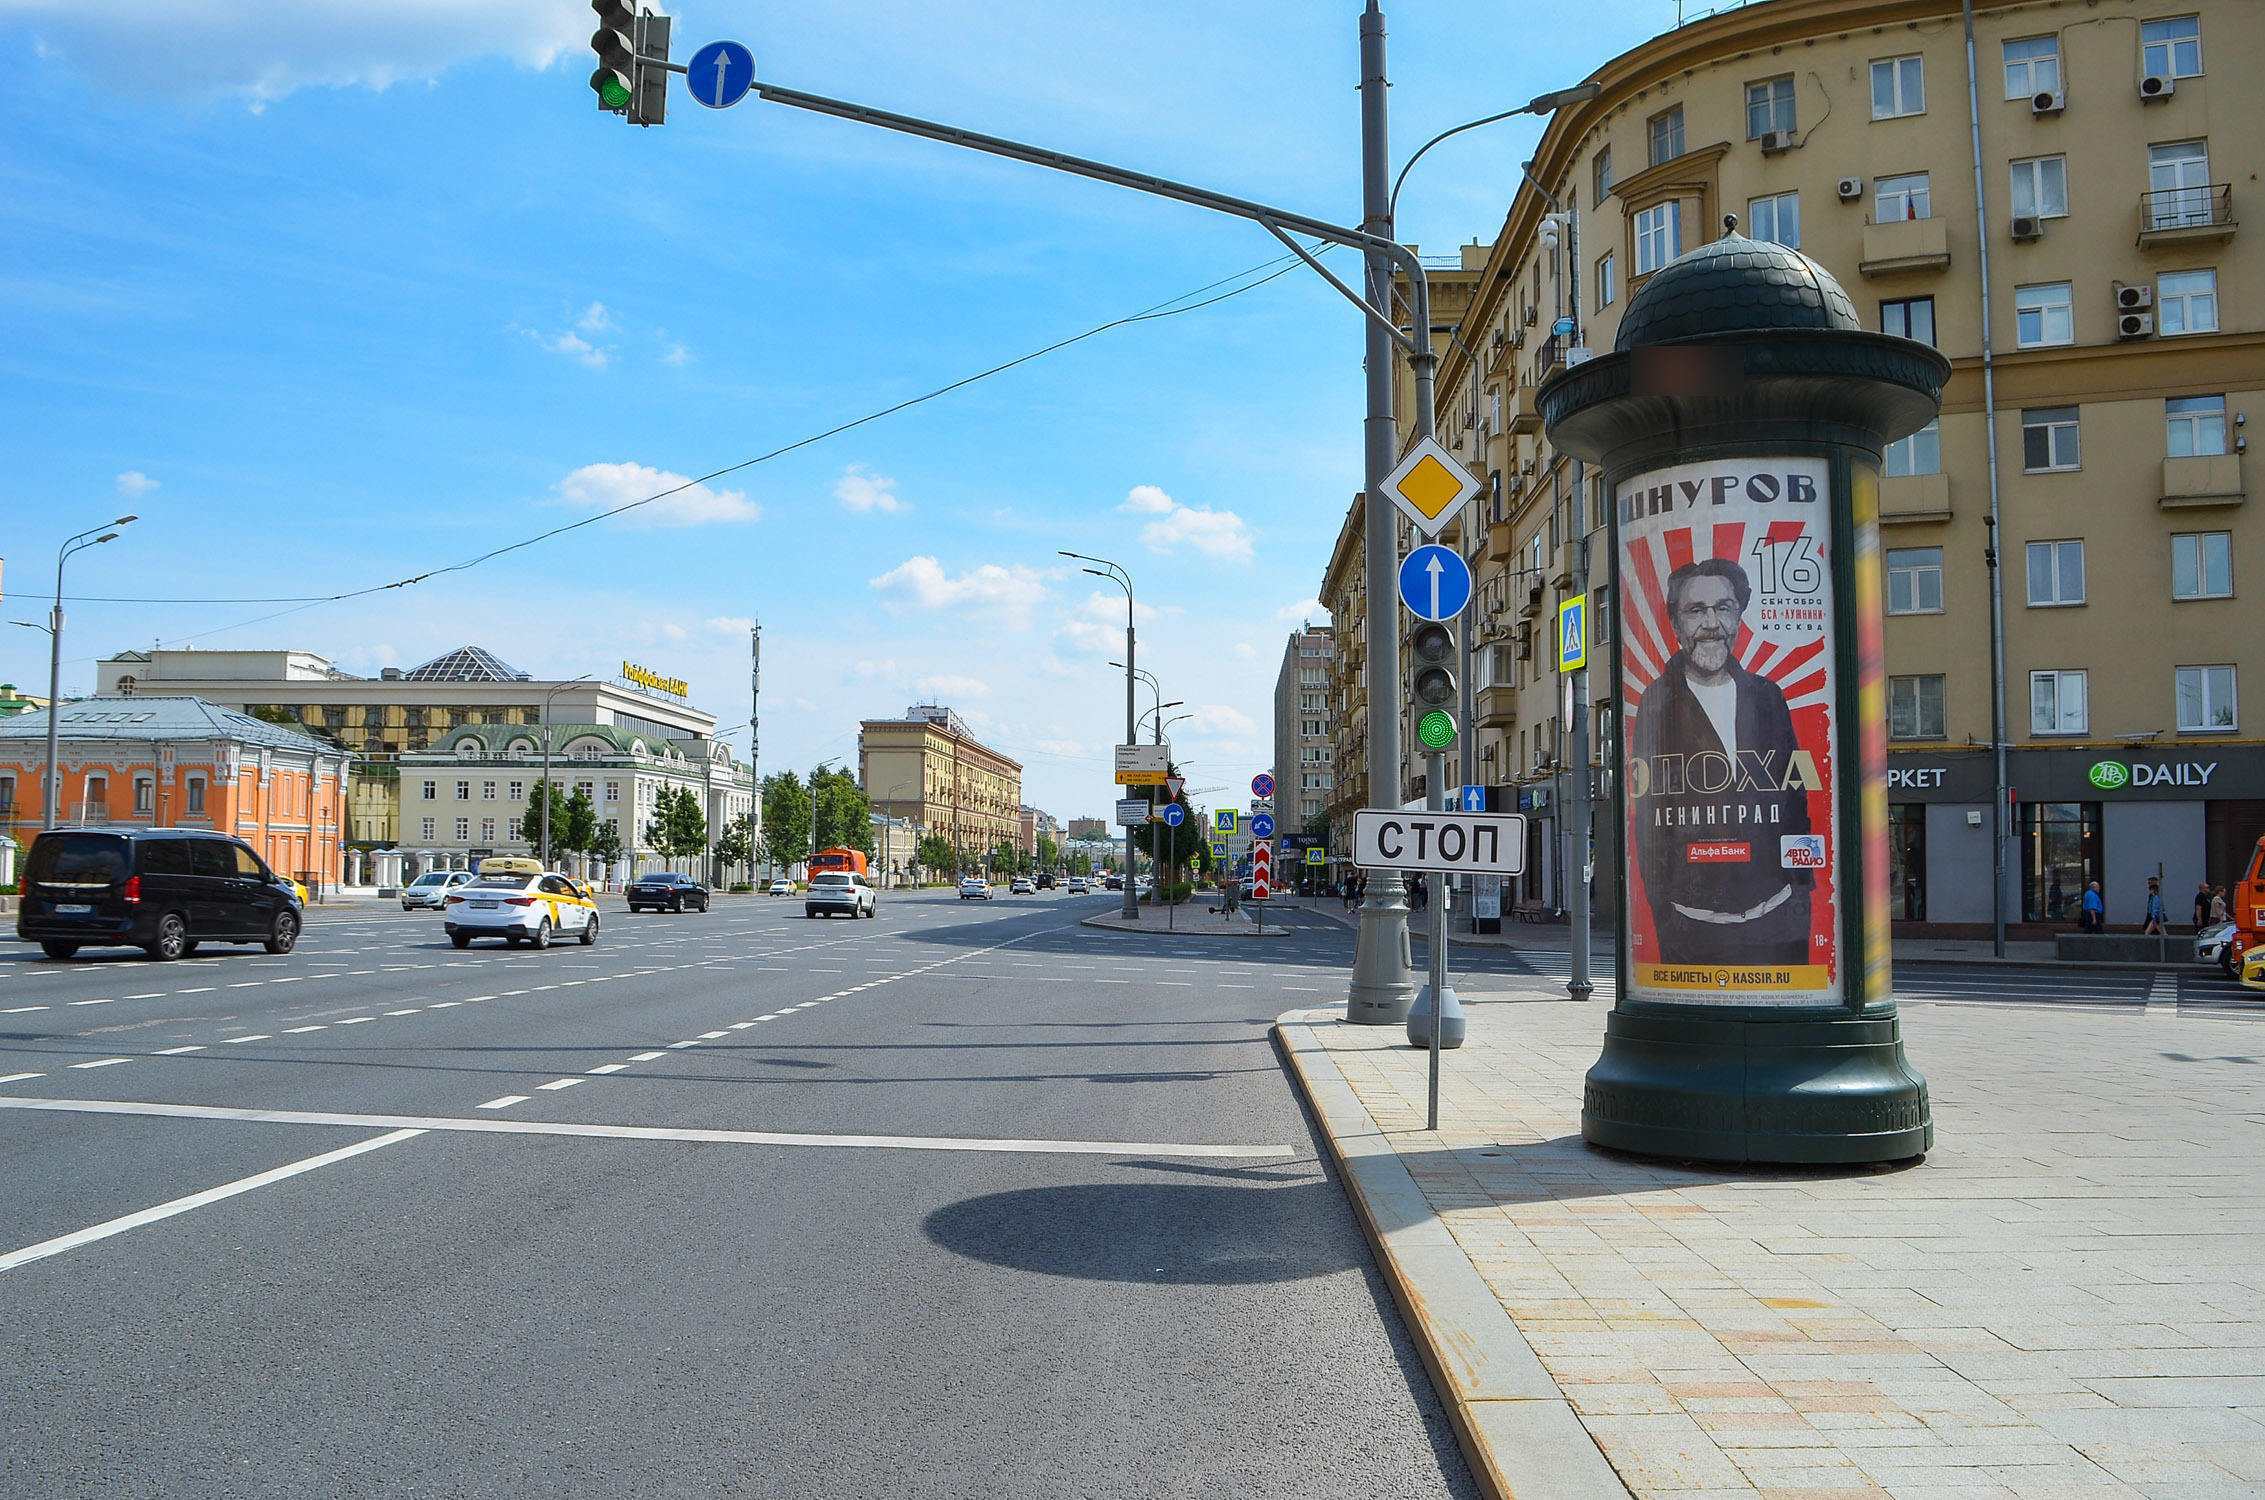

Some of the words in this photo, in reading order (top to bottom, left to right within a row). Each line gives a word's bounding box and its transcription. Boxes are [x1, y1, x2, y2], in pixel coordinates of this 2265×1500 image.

[1752, 536, 1820, 594] 16
[1761, 609, 1777, 620] БСА
[623, 660, 668, 692] Райффайзен
[669, 676, 688, 698] БАНК
[1628, 750, 1823, 798] ЭПОХА
[2132, 762, 2218, 786] DAILY
[1655, 803, 1780, 826] ЛЕНИНГРАД
[1378, 821, 1498, 863] СТОП
[1690, 846, 1720, 857] Альфа
[1721, 846, 1746, 855] Банк
[1784, 848, 1810, 858] АВТО
[1792, 856, 1824, 866] РАДИО
[1814, 934, 1828, 947] 18+
[1653, 970, 1668, 982] ВСЕ
[1670, 971, 1712, 983] БИЛЕТЫ
[1733, 972, 1790, 984] KASSIR.RU
